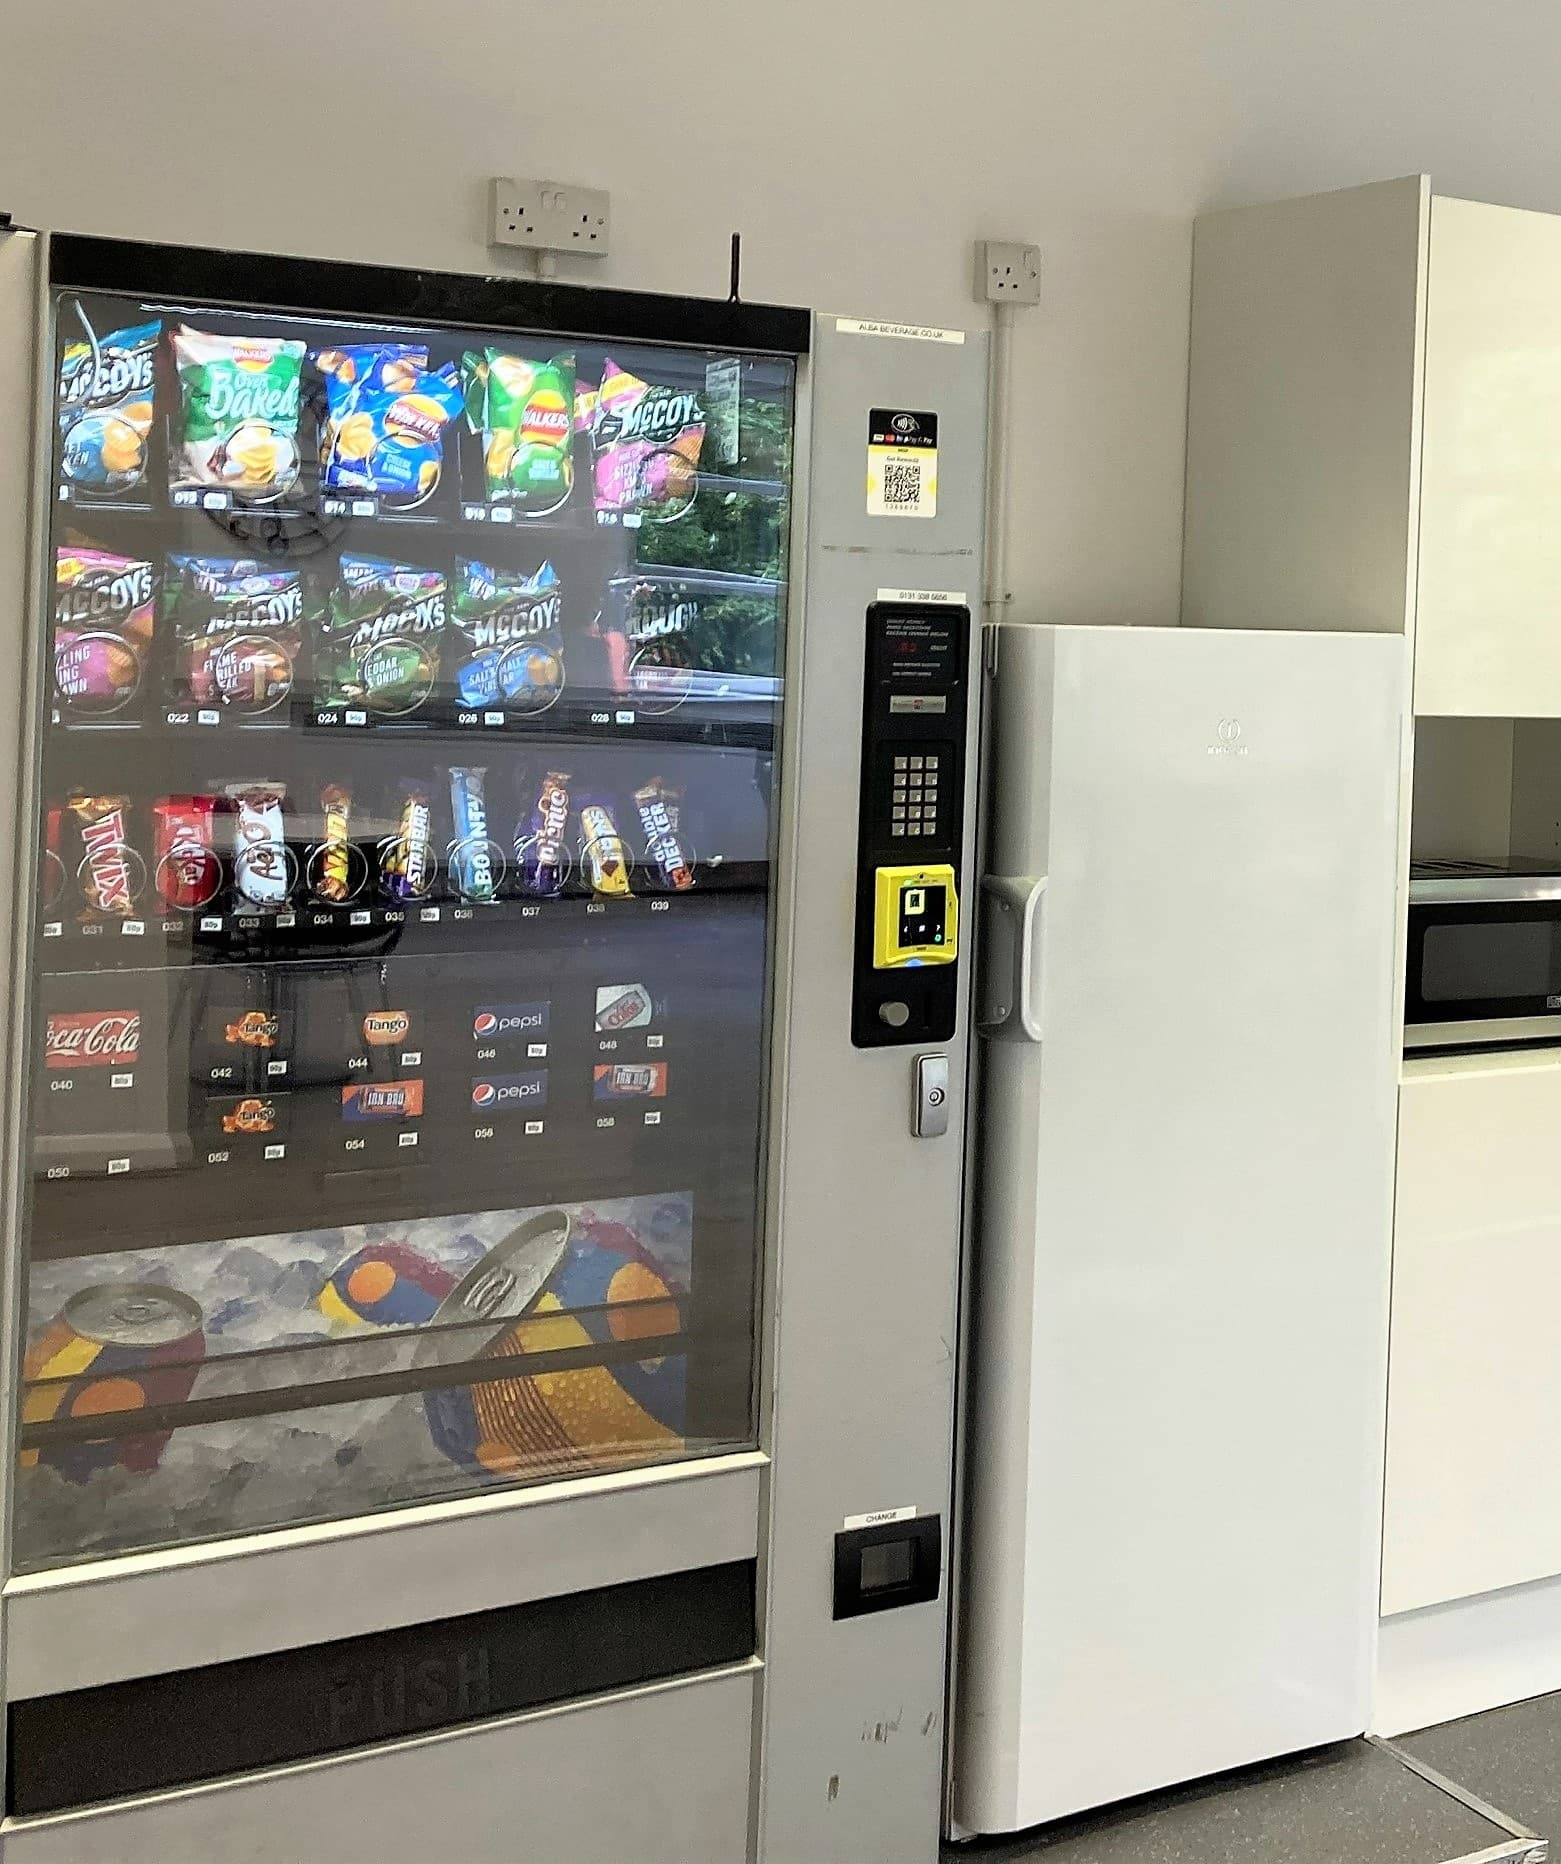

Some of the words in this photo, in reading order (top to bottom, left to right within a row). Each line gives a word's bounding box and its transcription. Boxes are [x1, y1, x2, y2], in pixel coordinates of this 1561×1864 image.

[205, 370, 299, 419] Baked
[522, 408, 570, 428] WALKERS
[217, 661, 252, 682] RILLED
[376, 668, 405, 687] ONION
[167, 713, 190, 723] 022
[317, 713, 338, 724] 024
[82, 811, 129, 907] TWIX
[522, 907, 540, 916] 037
[651, 901, 669, 911] 039
[313, 914, 334, 924] 034
[367, 1019, 407, 1033] Tango
[499, 1013, 542, 1031] pepsi
[348, 1057, 368, 1069] 044
[211, 1067, 233, 1079] 042
[50, 1080, 73, 1091] 040
[497, 1081, 540, 1101] pepsi
[345, 1139, 365, 1150] 054
[865, 1511, 897, 1523] CHANGE
